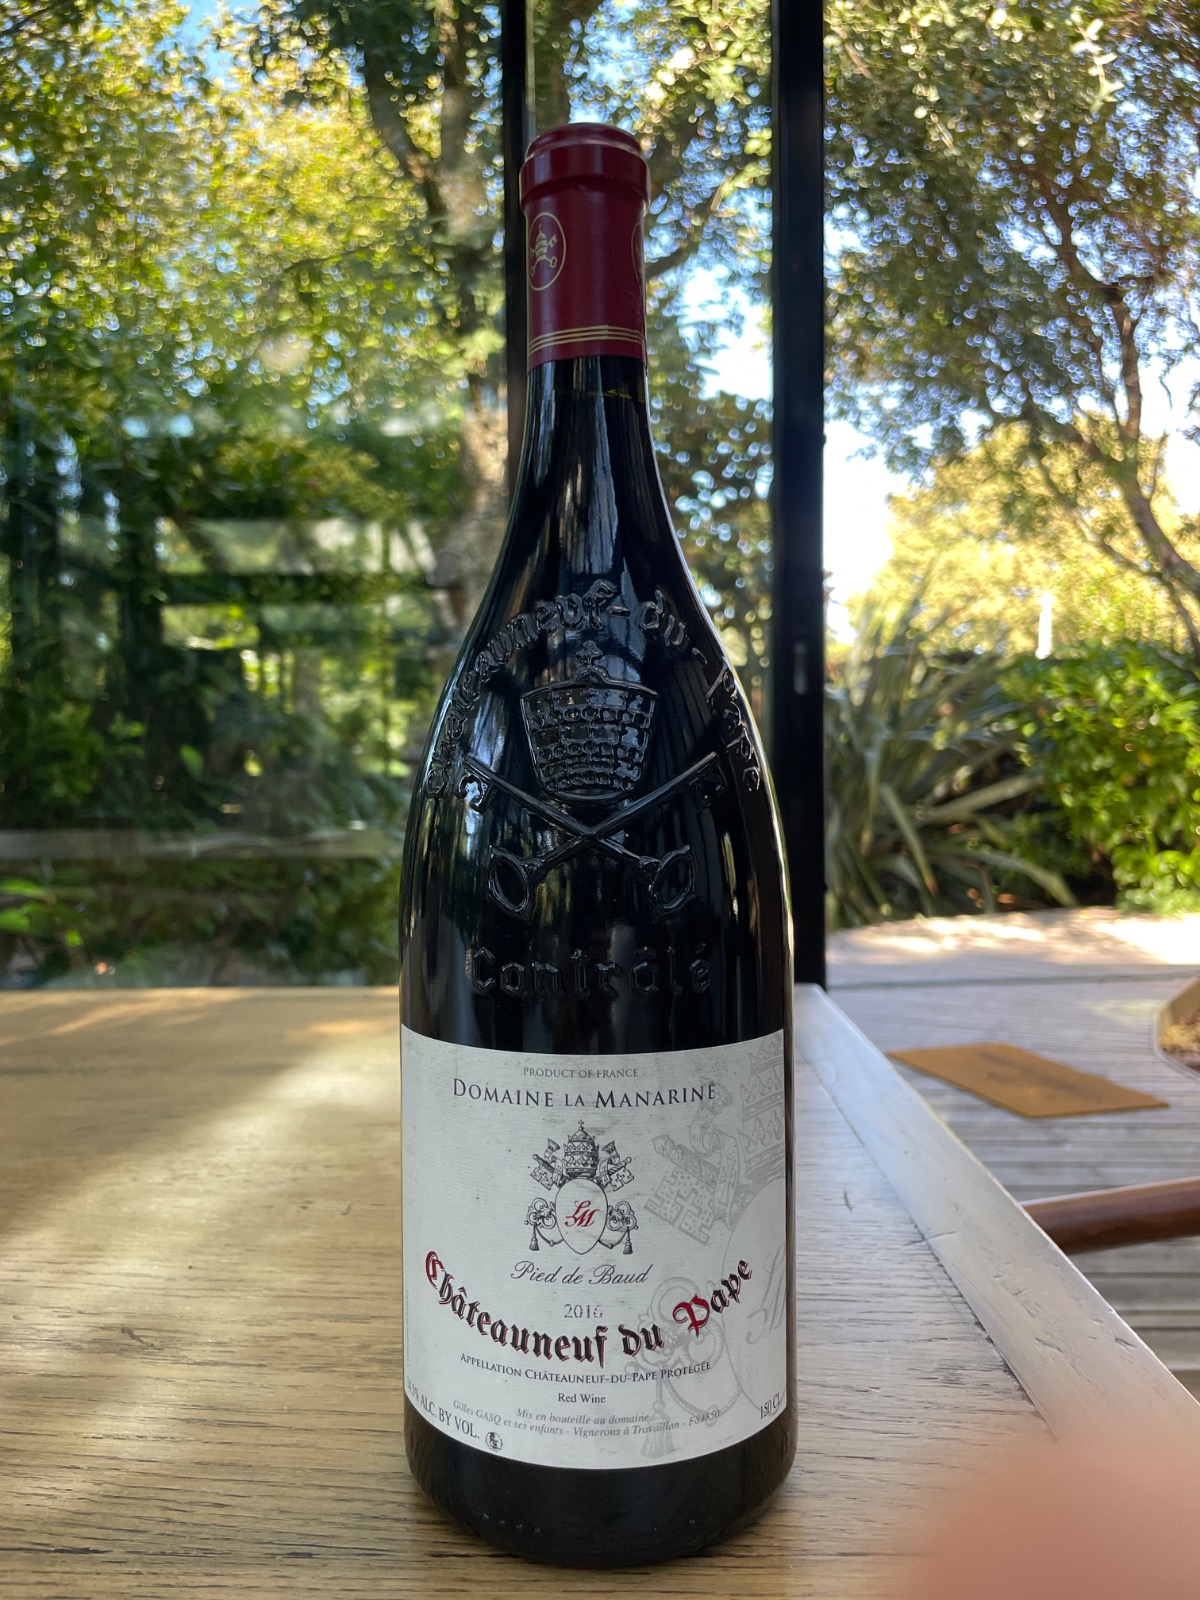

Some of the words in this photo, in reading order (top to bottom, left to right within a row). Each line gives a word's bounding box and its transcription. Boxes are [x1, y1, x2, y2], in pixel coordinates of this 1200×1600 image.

[523, 1067, 575, 1078] PRODUCT
[578, 1069, 593, 1079] OF
[597, 1068, 638, 1079] FRANCE
[453, 1078, 554, 1108] DOMAINE
[565, 1093, 585, 1107] LA
[595, 1083, 716, 1109] MANARINE
[510, 1260, 562, 1282] Pied
[562, 1266, 583, 1285] de
[588, 1264, 653, 1285] Baud
[425, 1251, 608, 1369] Châteauneuf
[618, 1324, 664, 1357] du
[672, 1259, 752, 1338] Pape
[564, 1303, 603, 1318] 2016
[460, 1353, 522, 1377] APPELLATION
[661, 1361, 712, 1379] PROTÉGÉE
[558, 1393, 577, 1403] Red
[580, 1393, 606, 1404] Wine
[760, 1399, 771, 1419] 150
[772, 1392, 781, 1411] CL
[421, 1394, 437, 1418] ALC.
[439, 1407, 452, 1426] BY
[454, 1415, 480, 1439] VOL.
[453, 1400, 474, 1416] Gilles
[475, 1409, 501, 1426] GASQ
[503, 1419, 512, 1428] et
[513, 1422, 527, 1431] ses
[530, 1422, 563, 1435] enfants
[573, 1426, 620, 1438] Vignerons
[623, 1425, 630, 1436] à
[632, 1421, 680, 1435] Travaillan
[516, 1408, 533, 1419] Mis
[549, 1412, 590, 1425] bouteille
[593, 1417, 606, 1425] au
[608, 1414, 649, 1425] domaine
